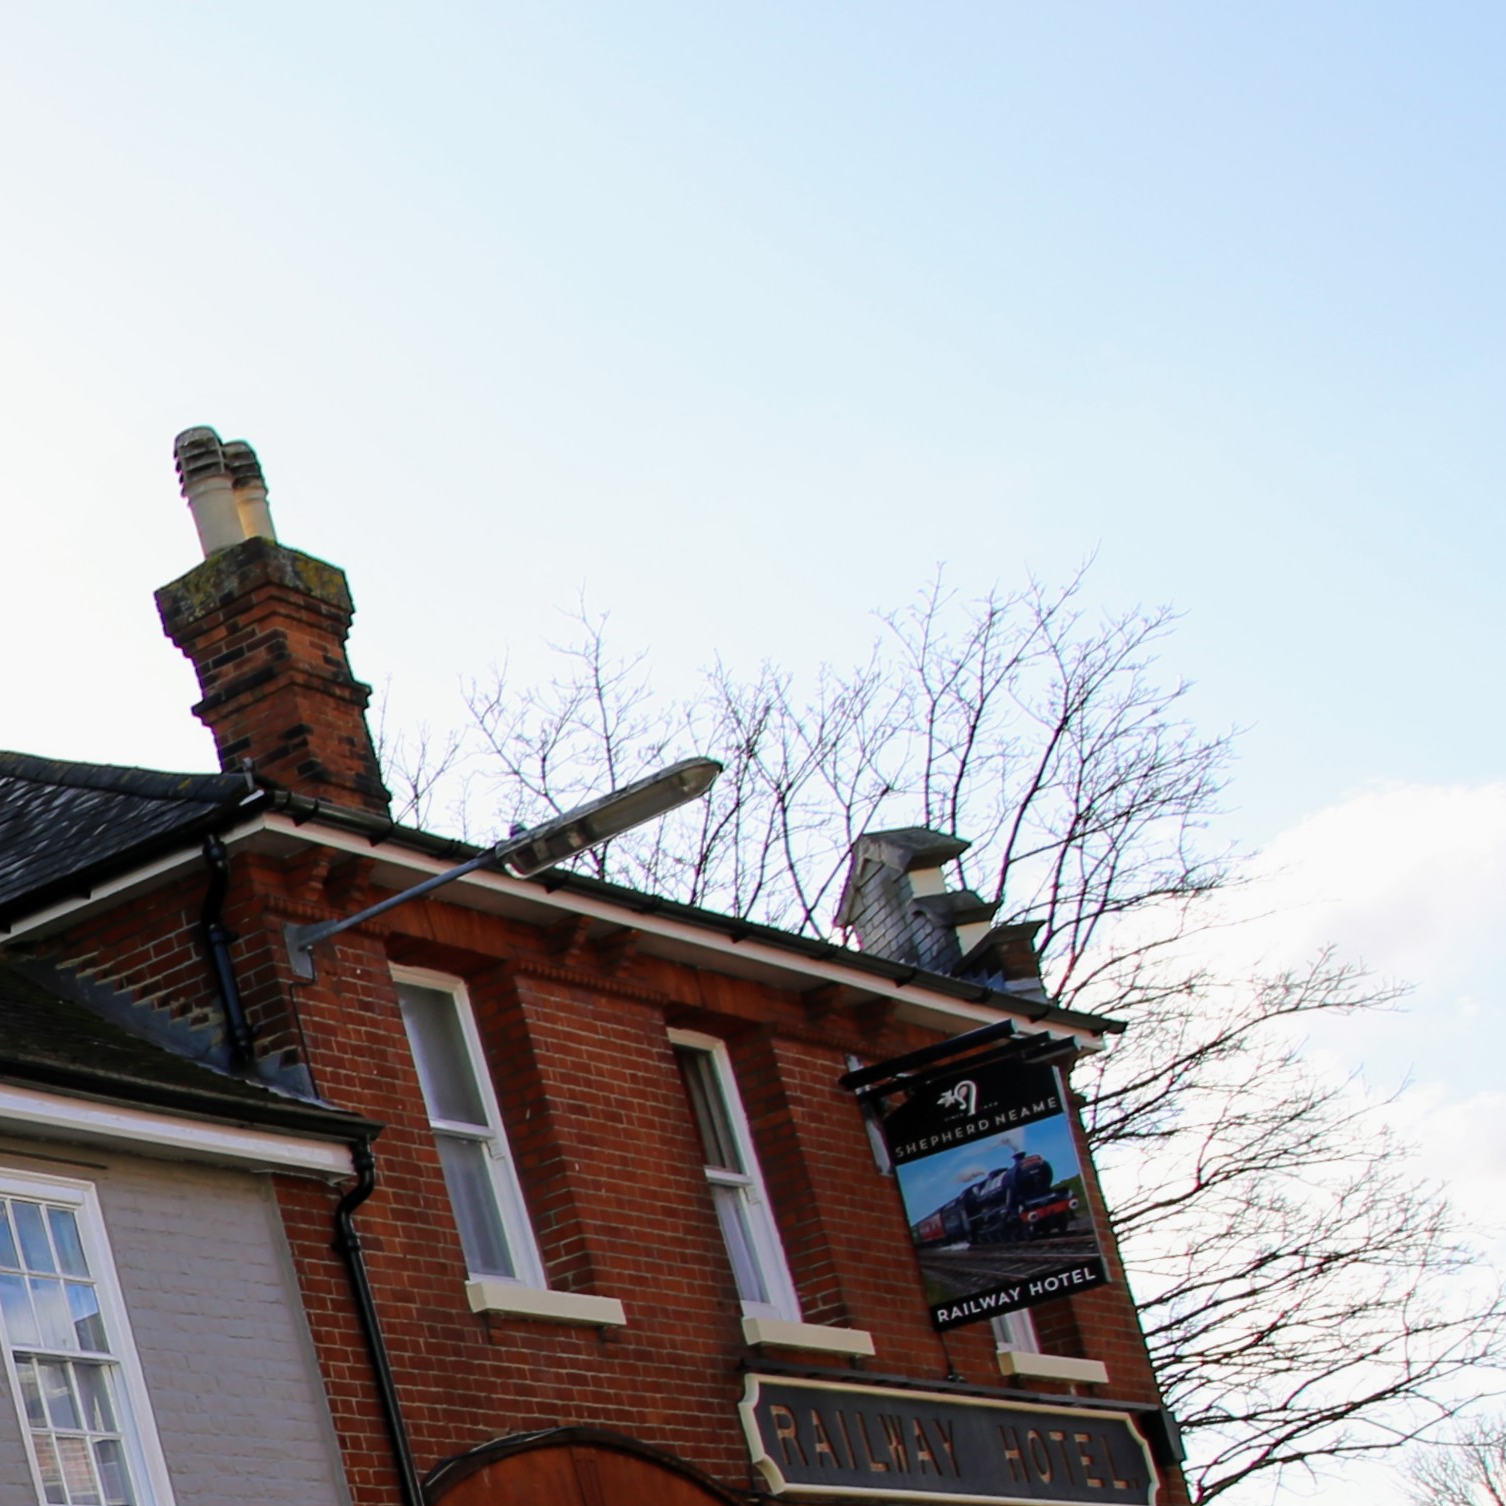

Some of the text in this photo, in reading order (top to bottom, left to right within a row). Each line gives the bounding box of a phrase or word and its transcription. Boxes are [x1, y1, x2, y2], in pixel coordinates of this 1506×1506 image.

[895, 1097, 1057, 1158] SHEPHERD NEAME
[937, 1267, 1096, 1323] RAILWAY HOTEL
[770, 1405, 961, 1477] RAILWAY
